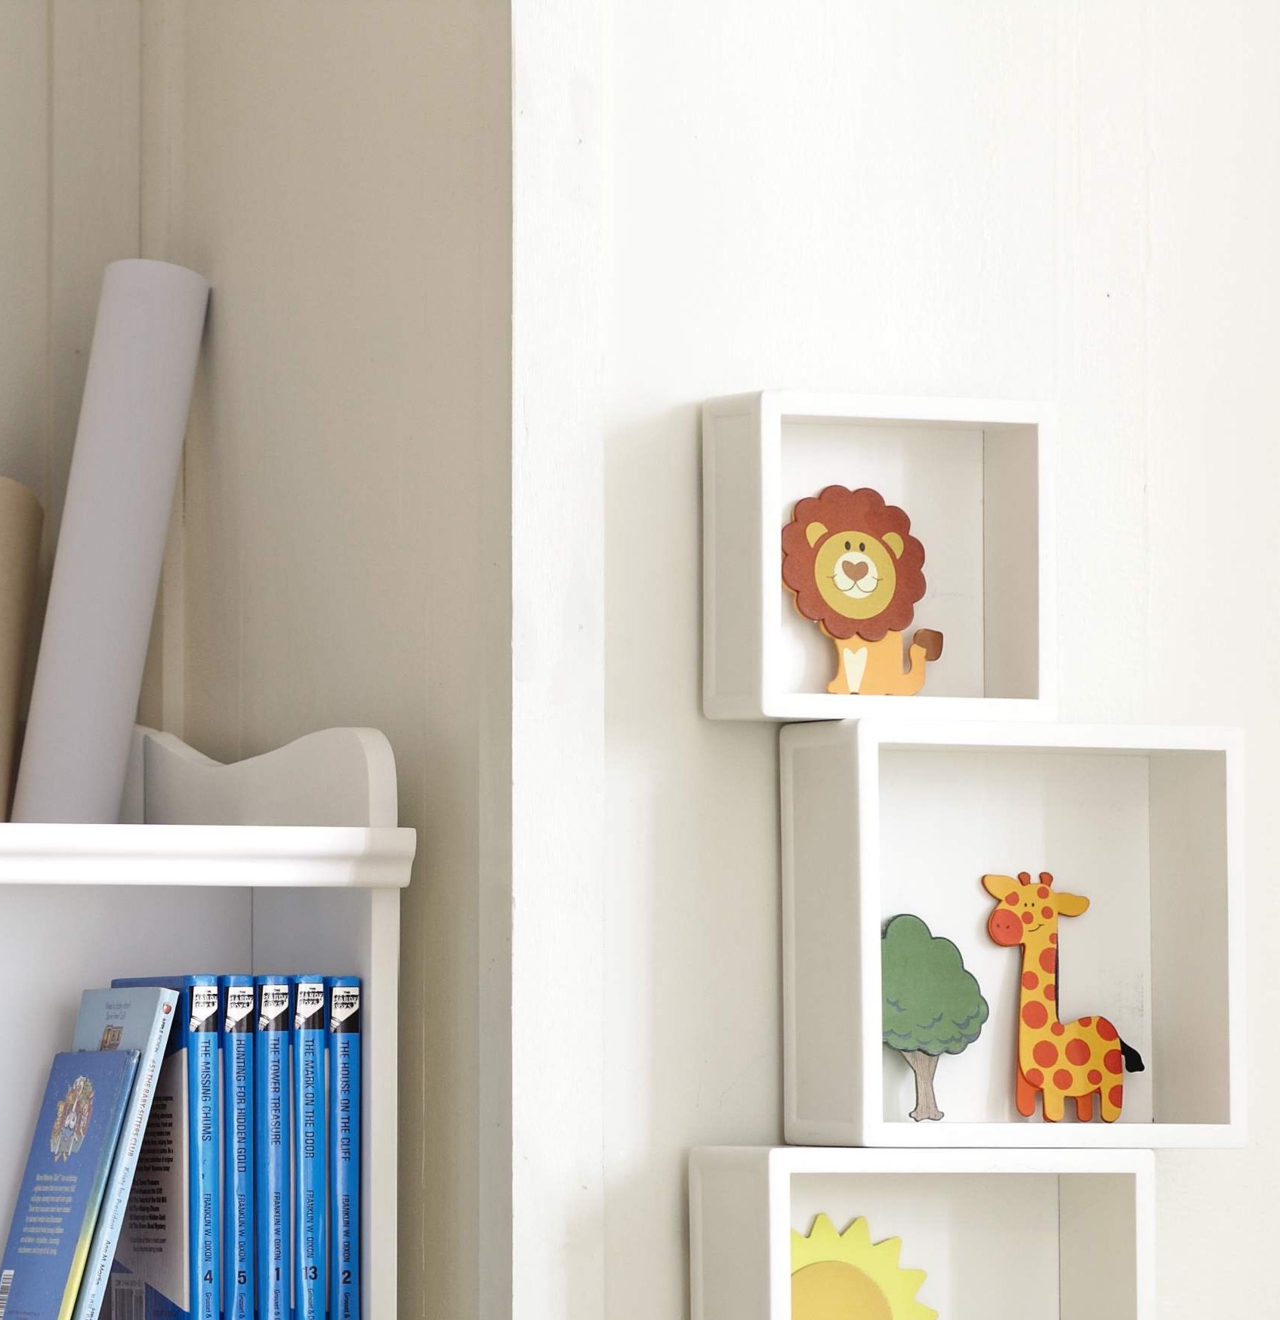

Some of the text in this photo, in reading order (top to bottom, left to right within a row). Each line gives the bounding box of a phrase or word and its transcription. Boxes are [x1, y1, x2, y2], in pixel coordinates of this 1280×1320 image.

[200, 1040, 212, 1142] THE MISSING CHUMS
[270, 1038, 281, 1146] THE TOWER TREASURE
[304, 1039, 314, 1159] THE MARK ON THE DOOR
[340, 1041, 351, 1162] THE HOUSE ON THE CLIFF
[235, 1039, 246, 1173] HUNTING FOR HIDDEN GOLD
[128, 1138, 138, 1157] CLUB
[204, 1193, 212, 1226] FRANKLIN
[238, 1194, 246, 1226] FRANKLIN
[306, 1190, 314, 1224] FRANKLIN
[342, 1194, 350, 1227] FRANKLIN
[204, 1241, 212, 1262] DIXON
[238, 1242, 246, 1263] DIXON
[306, 1238, 314, 1258] DIXON
[204, 1270, 213, 1284] 4
[238, 1270, 247, 1284] 5
[275, 1267, 280, 1282] 1
[302, 1266, 318, 1280] 13
[342, 1270, 352, 1284] 2
